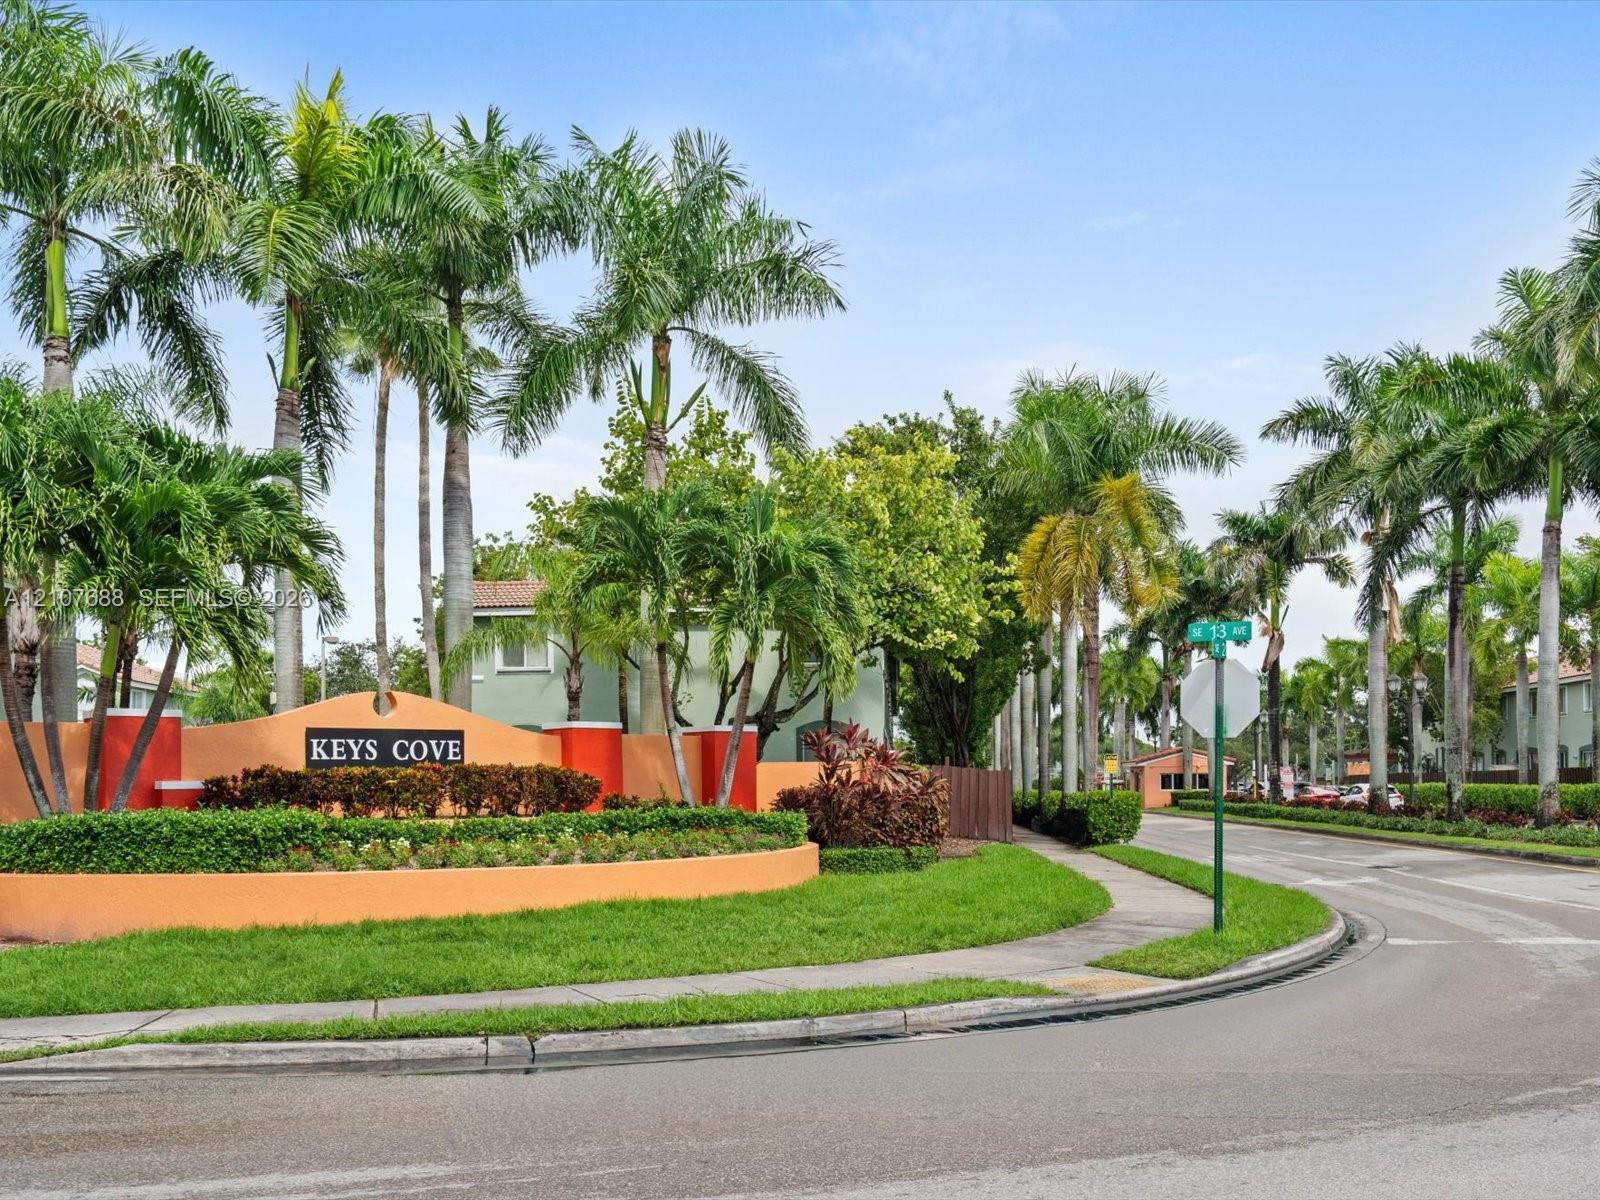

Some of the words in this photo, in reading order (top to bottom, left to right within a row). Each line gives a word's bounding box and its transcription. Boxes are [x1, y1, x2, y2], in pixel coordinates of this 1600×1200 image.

[1192, 627, 1203, 637] SE
[1209, 624, 1227, 639] 13
[1232, 626, 1247, 636] AVE
[310, 738, 378, 760] KEYS
[392, 739, 461, 761] COVE
